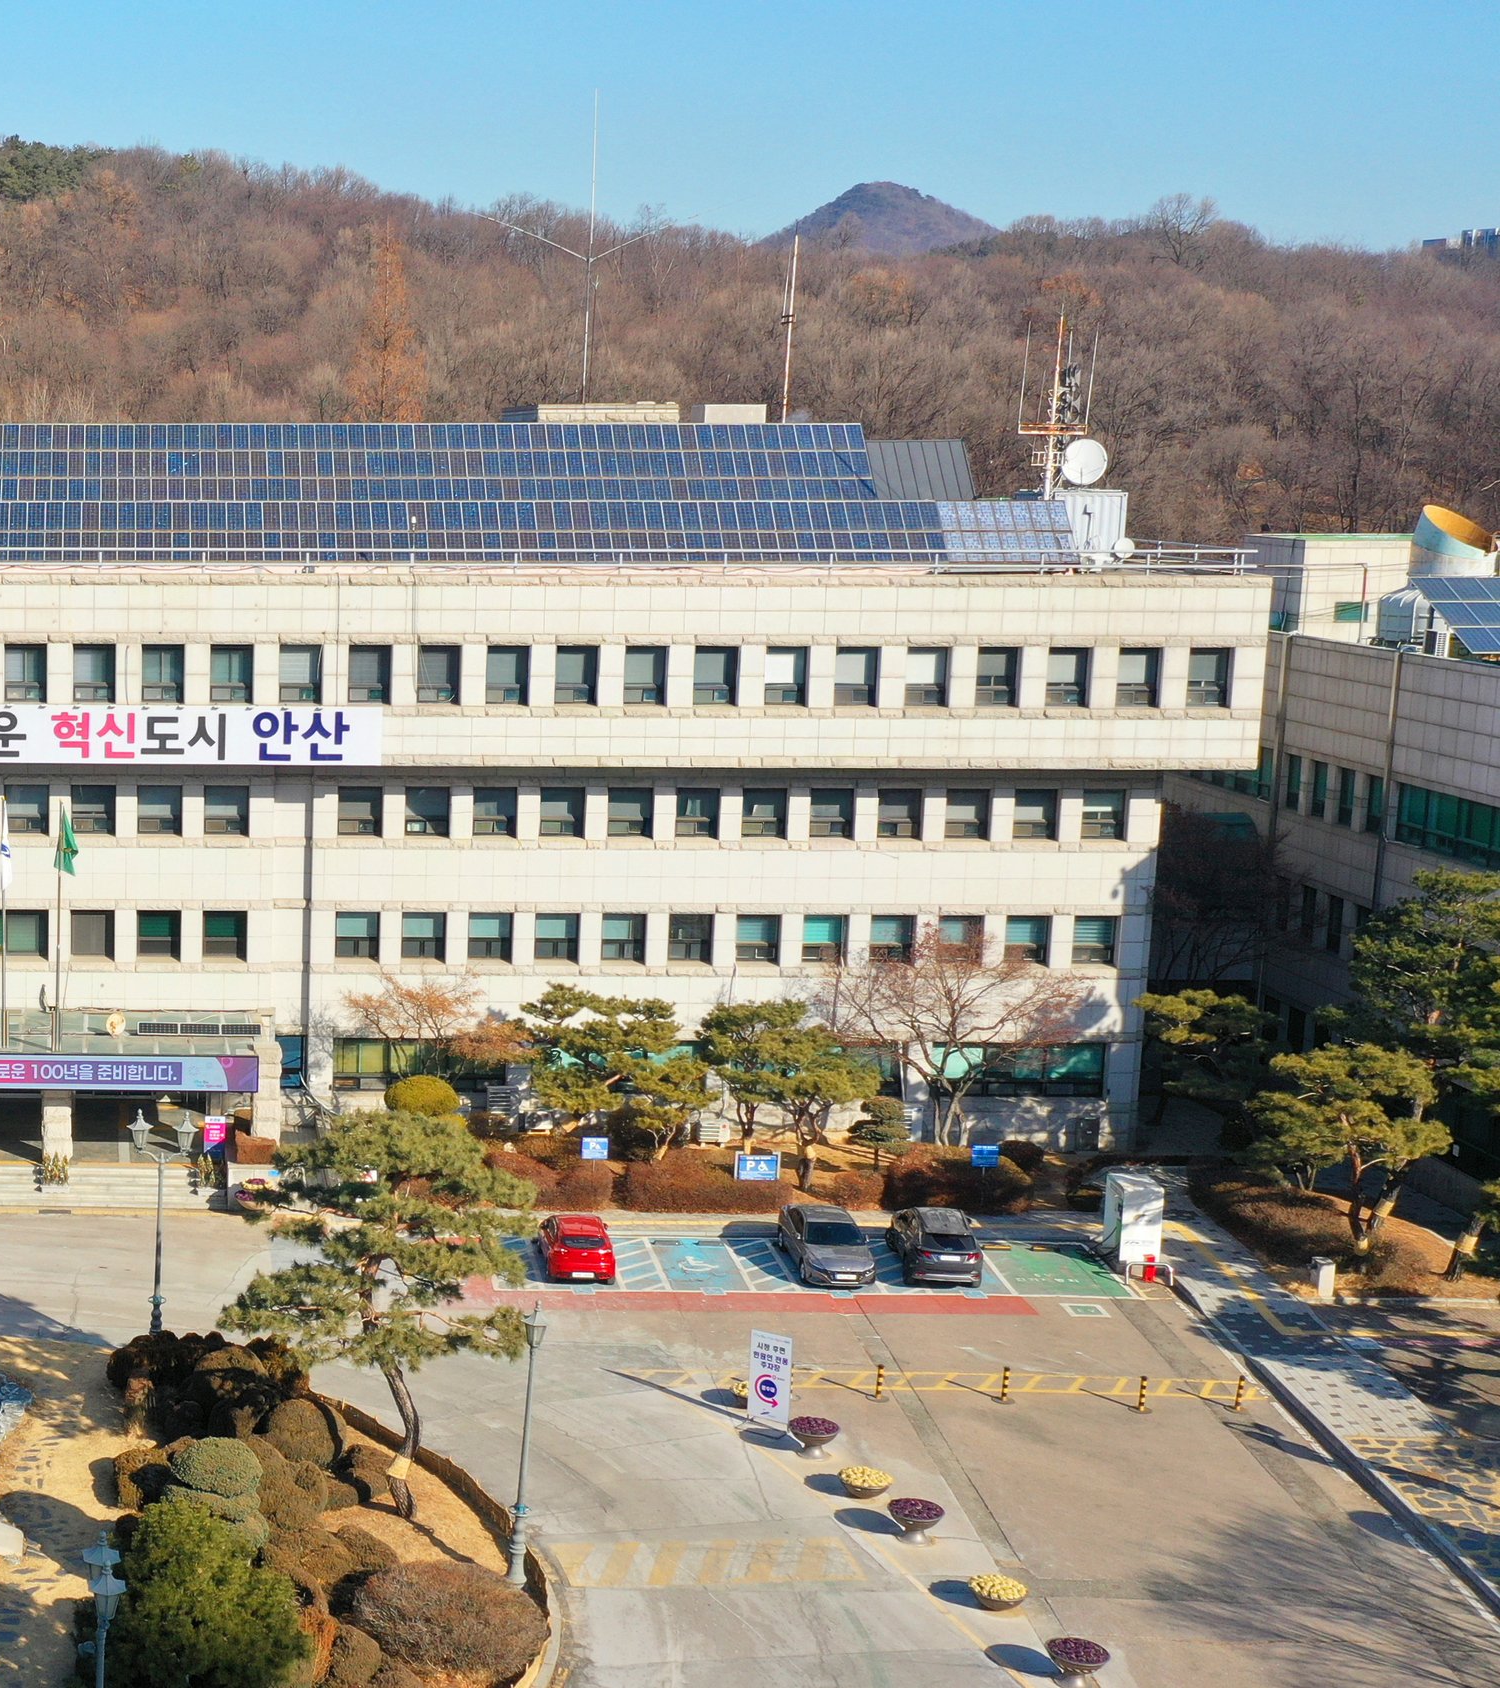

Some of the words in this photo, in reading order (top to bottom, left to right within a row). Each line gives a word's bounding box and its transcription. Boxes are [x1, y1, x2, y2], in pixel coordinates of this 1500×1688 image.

[51, 711, 227, 760] 혁신도시
[252, 711, 350, 761] 안산
[31, 1063, 94, 1081] 100년을
[96, 1063, 177, 1082] 준비합니다.
